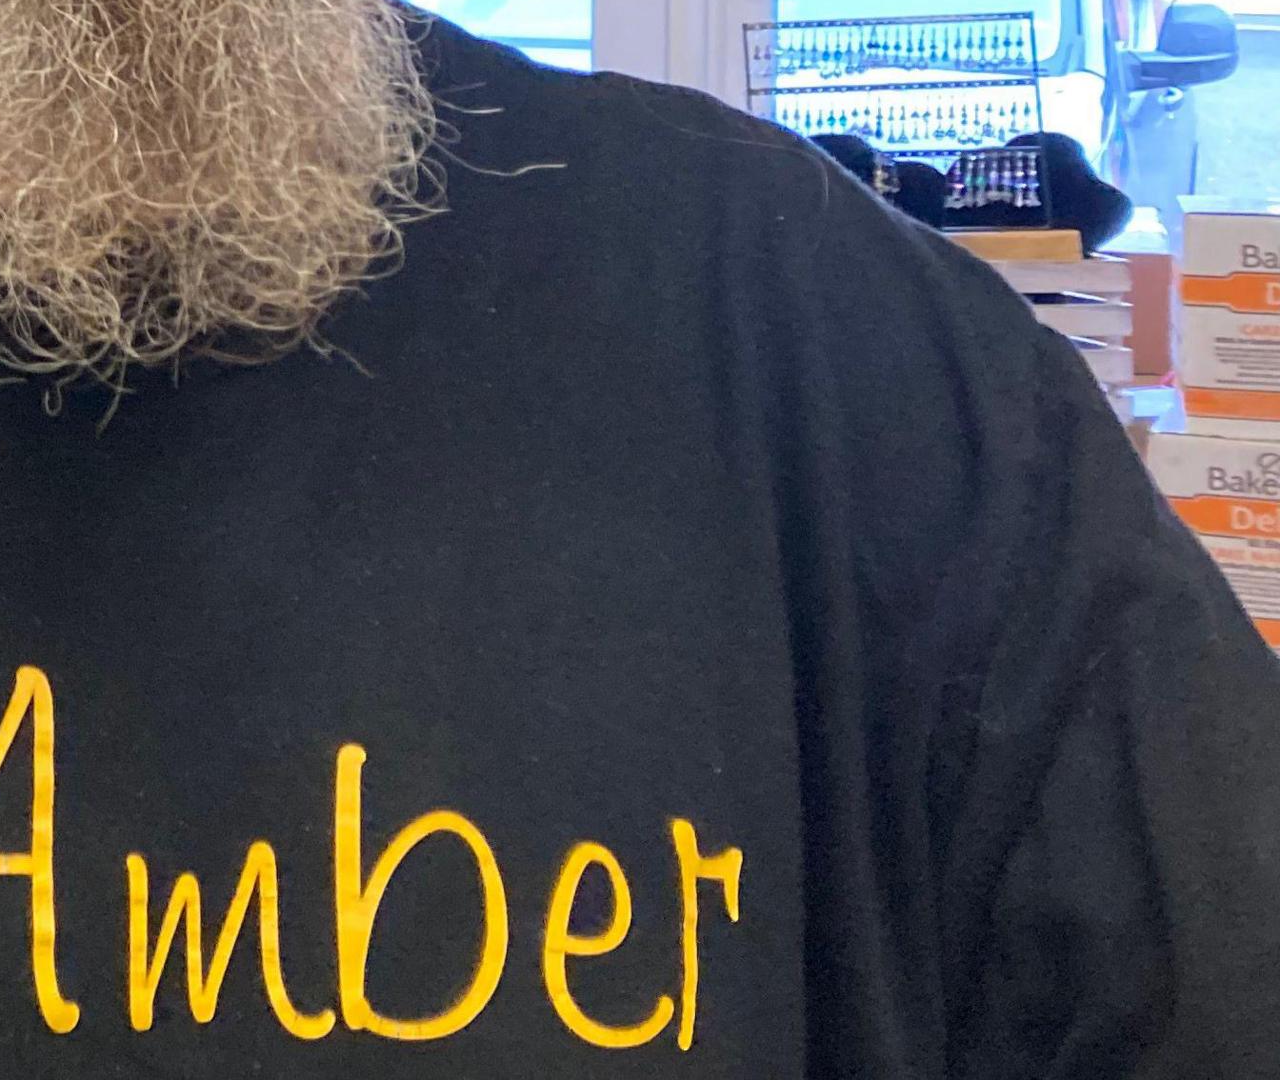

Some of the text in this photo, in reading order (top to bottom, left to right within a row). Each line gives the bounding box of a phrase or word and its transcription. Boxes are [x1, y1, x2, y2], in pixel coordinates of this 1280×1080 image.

[1241, 244, 1280, 269] Ba
[1265, 281, 1280, 306] D
[1207, 466, 1280, 497] Bake
